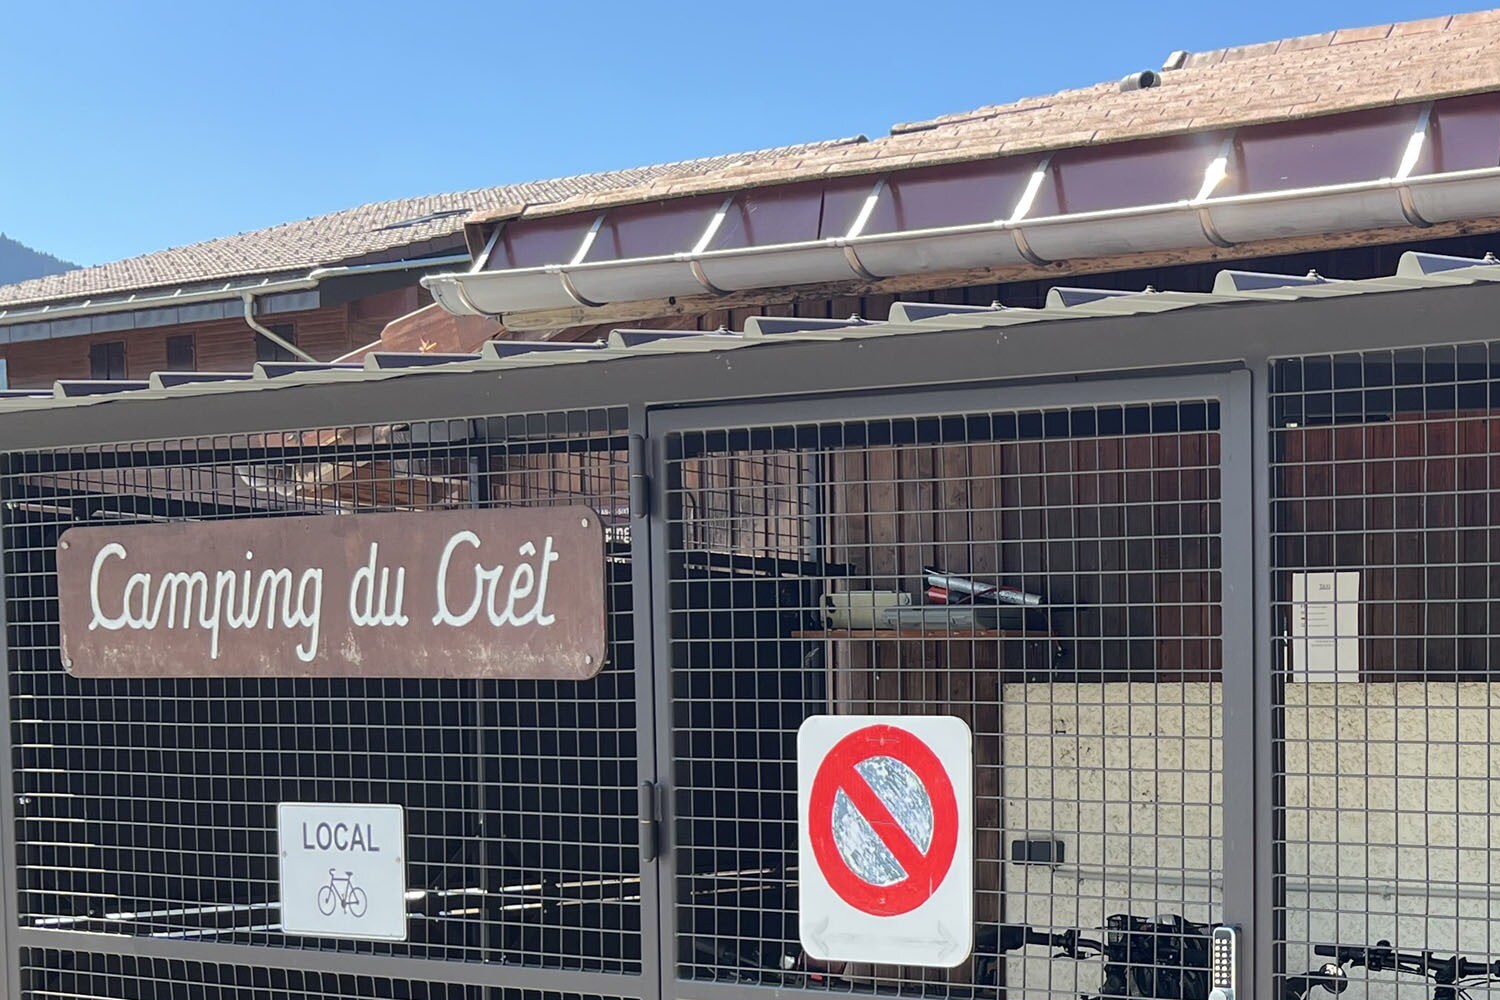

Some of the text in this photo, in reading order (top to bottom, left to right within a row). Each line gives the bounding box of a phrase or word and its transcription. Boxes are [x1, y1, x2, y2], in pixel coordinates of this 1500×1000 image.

[88, 530, 560, 663] Camping du Crêt
[303, 821, 380, 852] LOCAL
